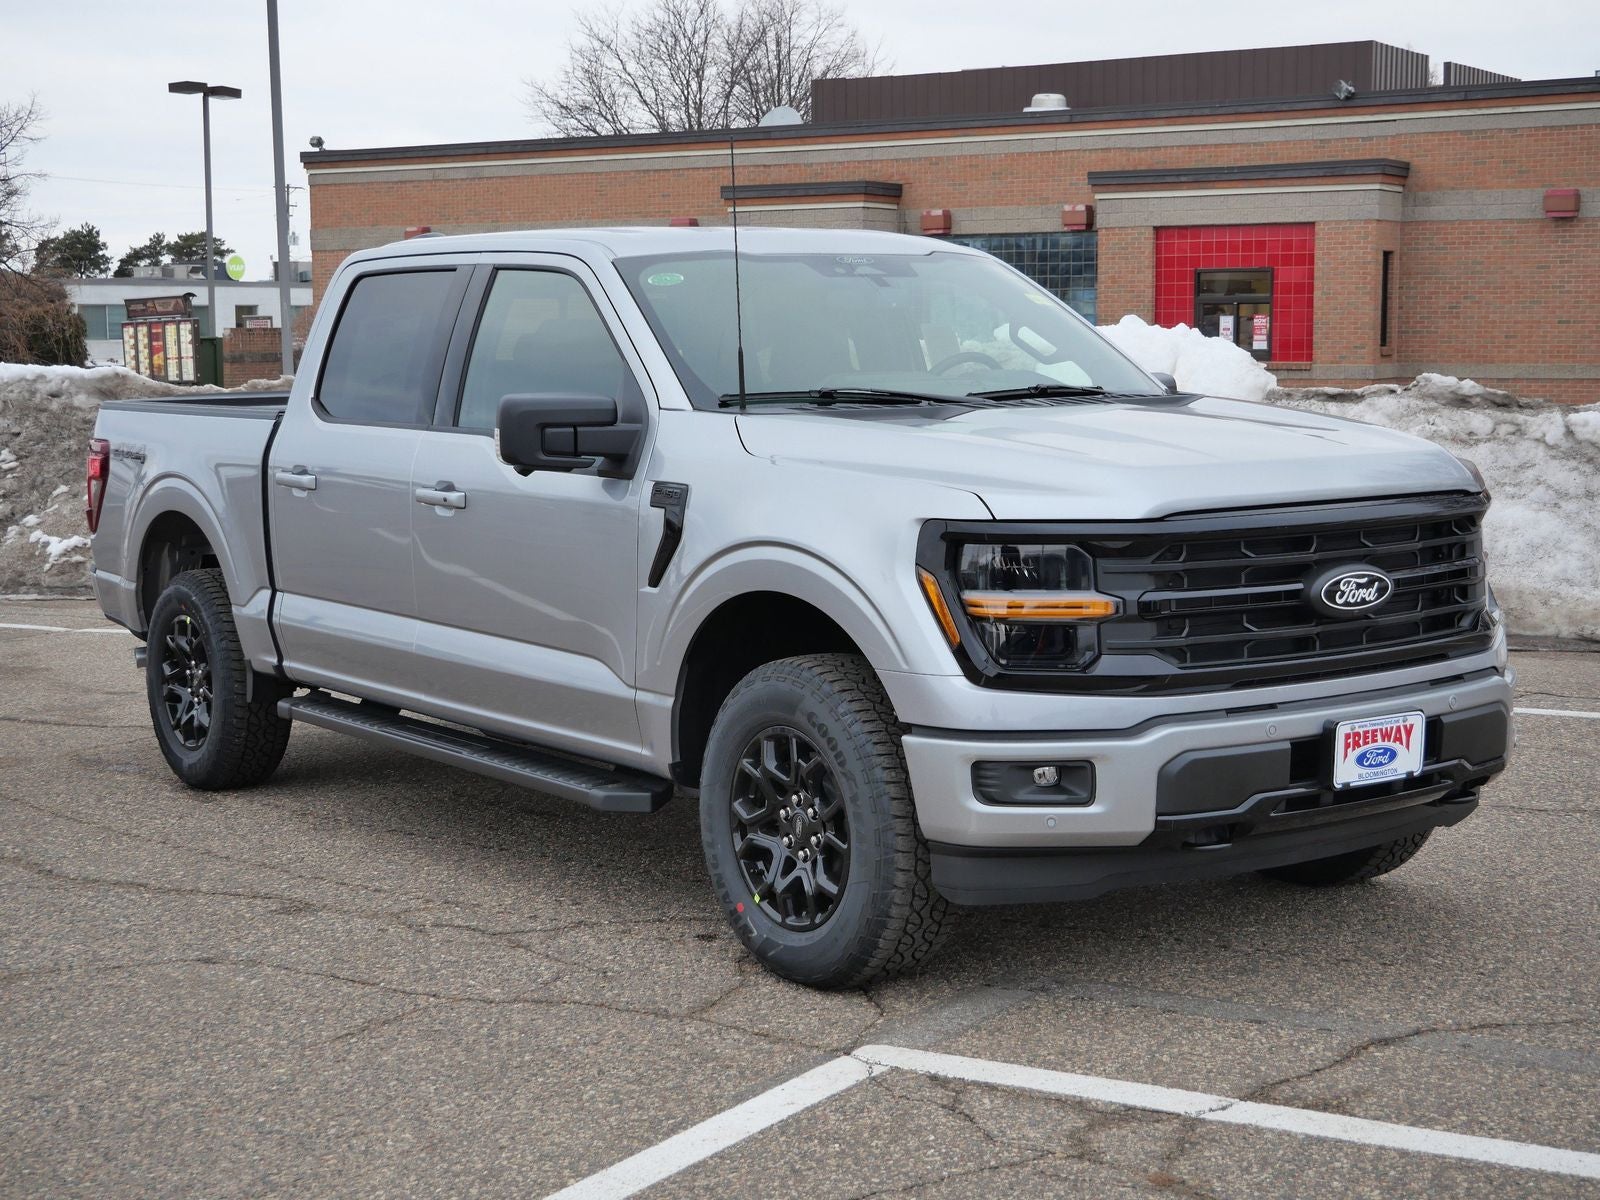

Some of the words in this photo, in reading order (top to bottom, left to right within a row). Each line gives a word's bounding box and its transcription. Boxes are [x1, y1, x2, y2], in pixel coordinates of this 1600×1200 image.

[1336, 577, 1379, 605] Ford
[1343, 723, 1414, 765] FREEWAY
[1363, 748, 1390, 766] Ford
[1358, 768, 1398, 779] BLOOMINGTON
